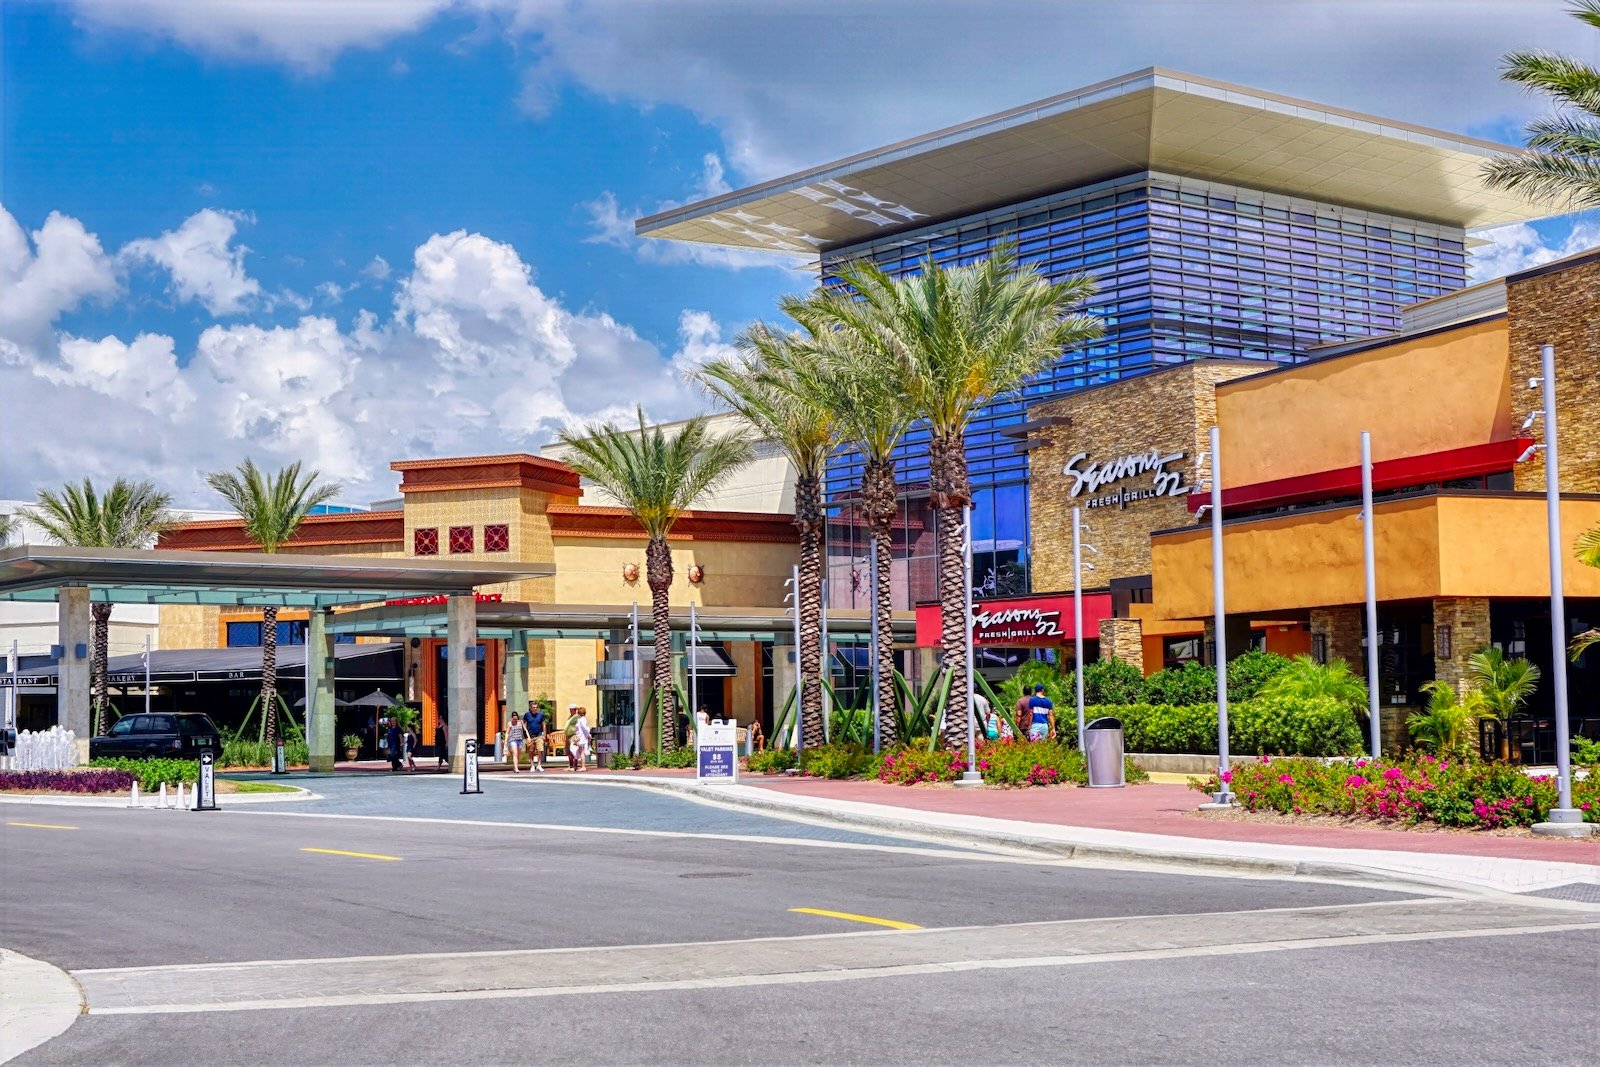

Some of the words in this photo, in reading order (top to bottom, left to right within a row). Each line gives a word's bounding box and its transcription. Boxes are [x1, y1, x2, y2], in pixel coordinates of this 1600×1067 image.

[1063, 450, 1183, 497] Seasons
[1153, 464, 1189, 496] 52
[1085, 495, 1118, 509] FRESH
[1124, 488, 1155, 502] GRILL
[1036, 617, 1064, 636] 52
